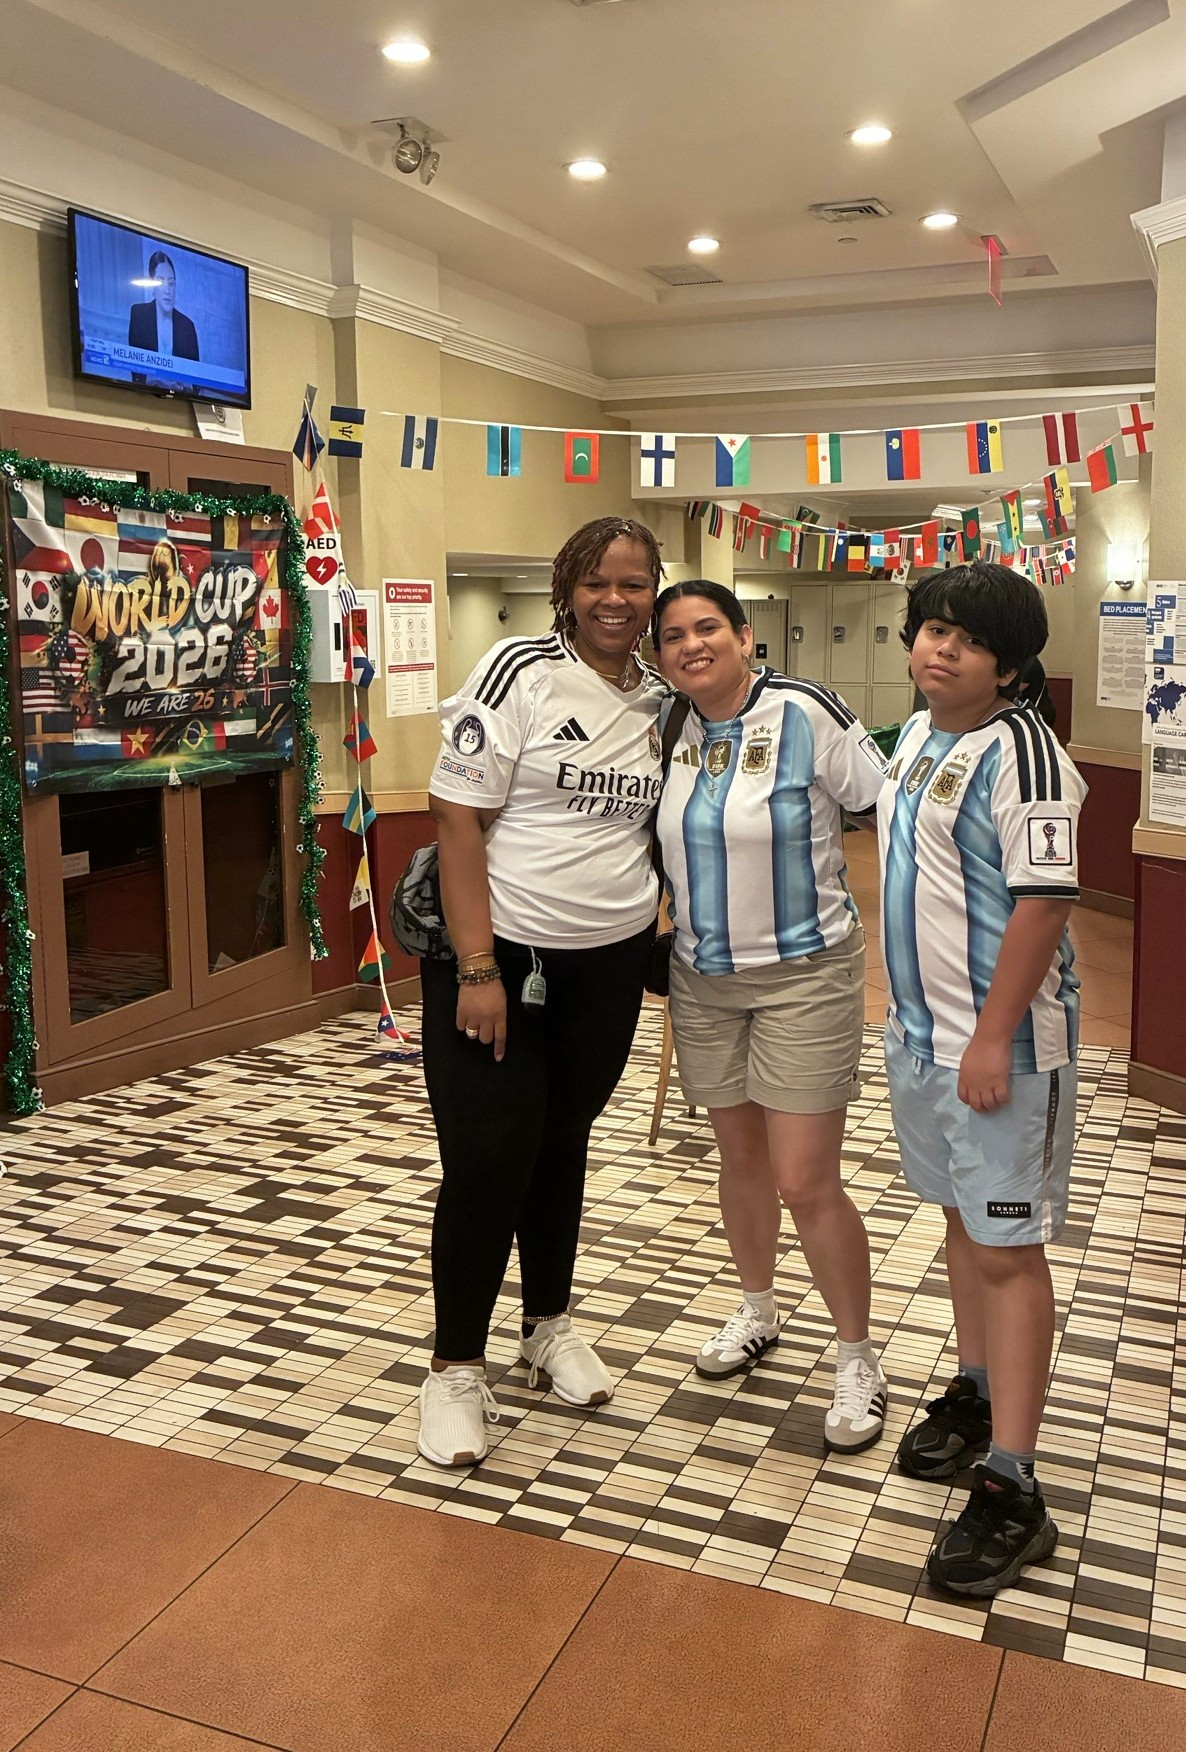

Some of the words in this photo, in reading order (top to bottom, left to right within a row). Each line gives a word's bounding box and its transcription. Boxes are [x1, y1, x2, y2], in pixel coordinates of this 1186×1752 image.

[113, 347, 145, 363] MELANIE
[146, 355, 174, 369] ANZIDEI
[306, 538, 337, 550] AED
[71, 575, 191, 641] WORLD
[195, 565, 257, 626] CUP
[1104, 605, 1115, 613] BED
[1156, 597, 1162, 607] 5
[105, 623, 233, 696] 2026
[124, 696, 155, 717] WE
[157, 693, 190, 714] ARE
[191, 688, 215, 711] 26
[464, 733, 476, 743] 15
[1155, 729, 1177, 737] LANGUAGE
[440, 760, 484, 780] FOUNDATION
[567, 795, 600, 815] FLY
